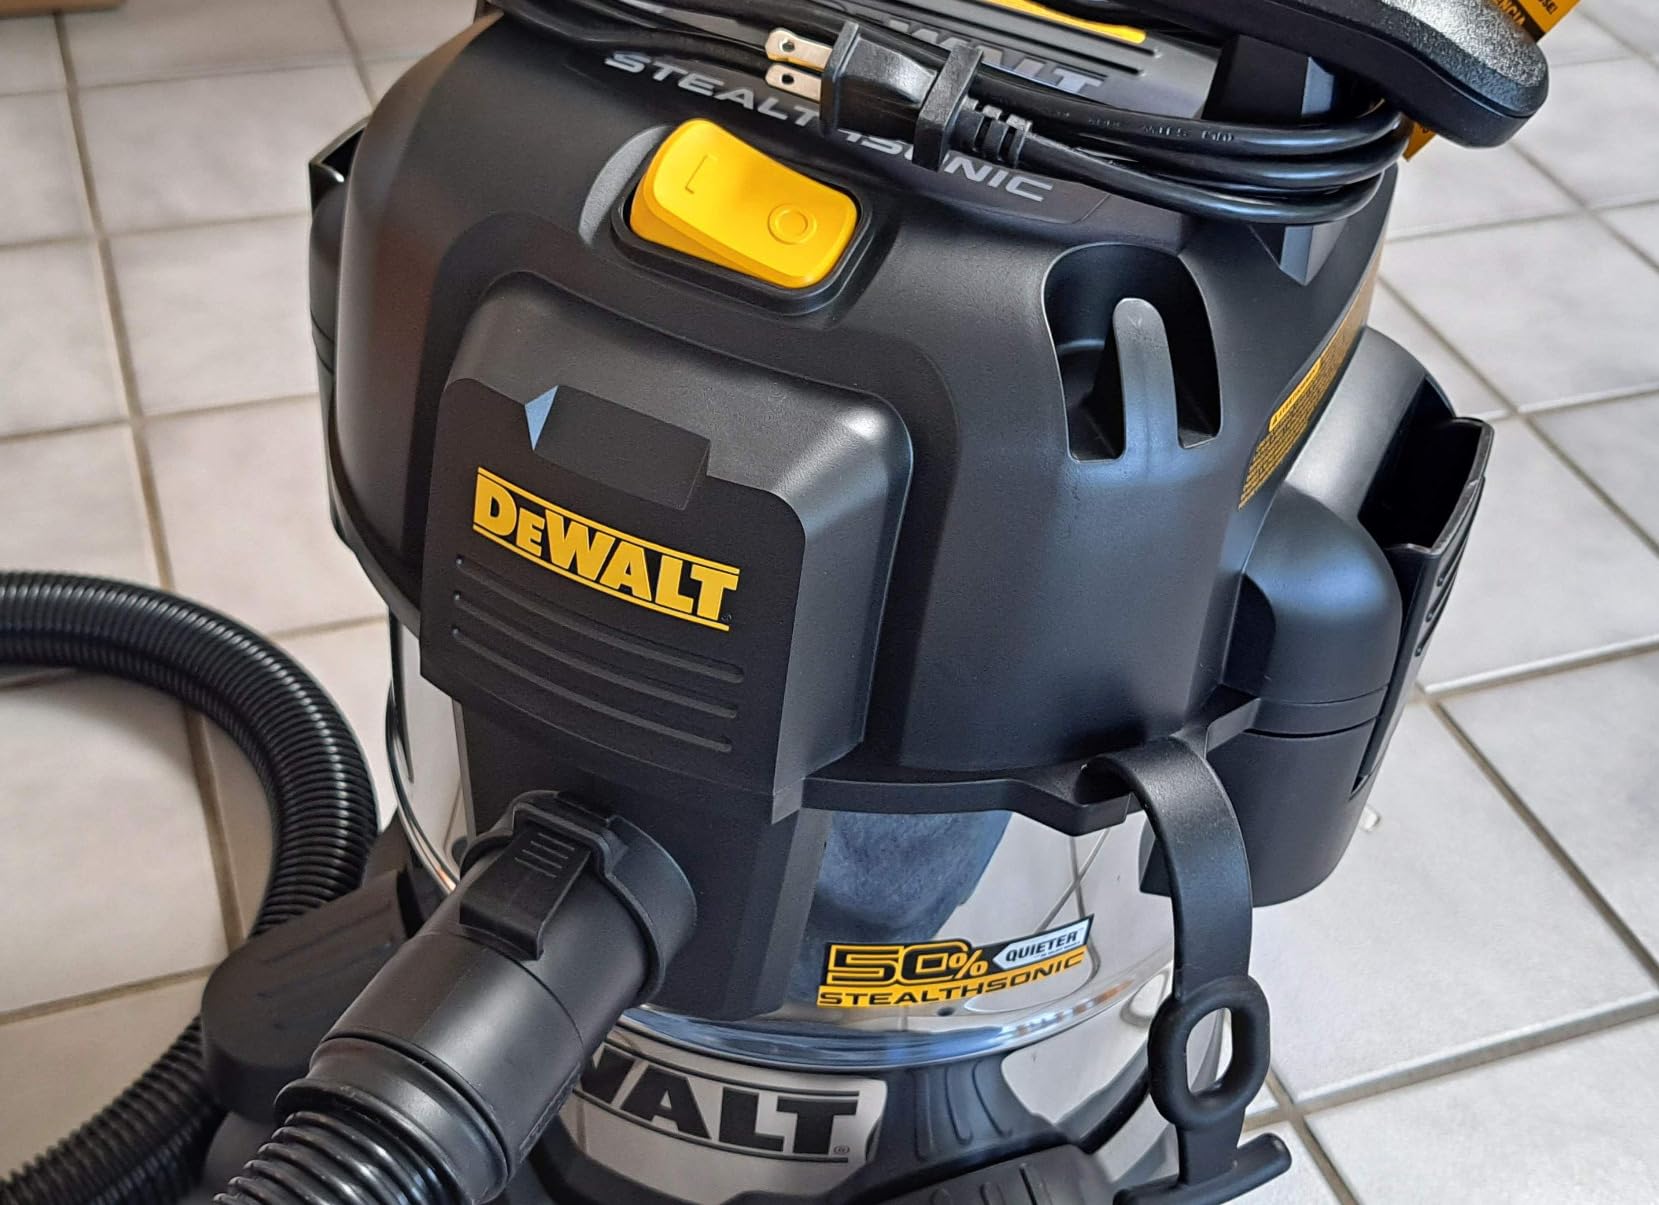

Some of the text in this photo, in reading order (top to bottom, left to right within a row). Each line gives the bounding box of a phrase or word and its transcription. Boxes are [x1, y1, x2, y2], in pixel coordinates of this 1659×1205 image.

[604, 51, 1053, 202] STEALTSNIC
[473, 473, 739, 621] DEWALT
[819, 951, 1085, 1006] STEALTHSONIC
[826, 941, 989, 986] 50%
[1005, 930, 1079, 962] QUIETER
